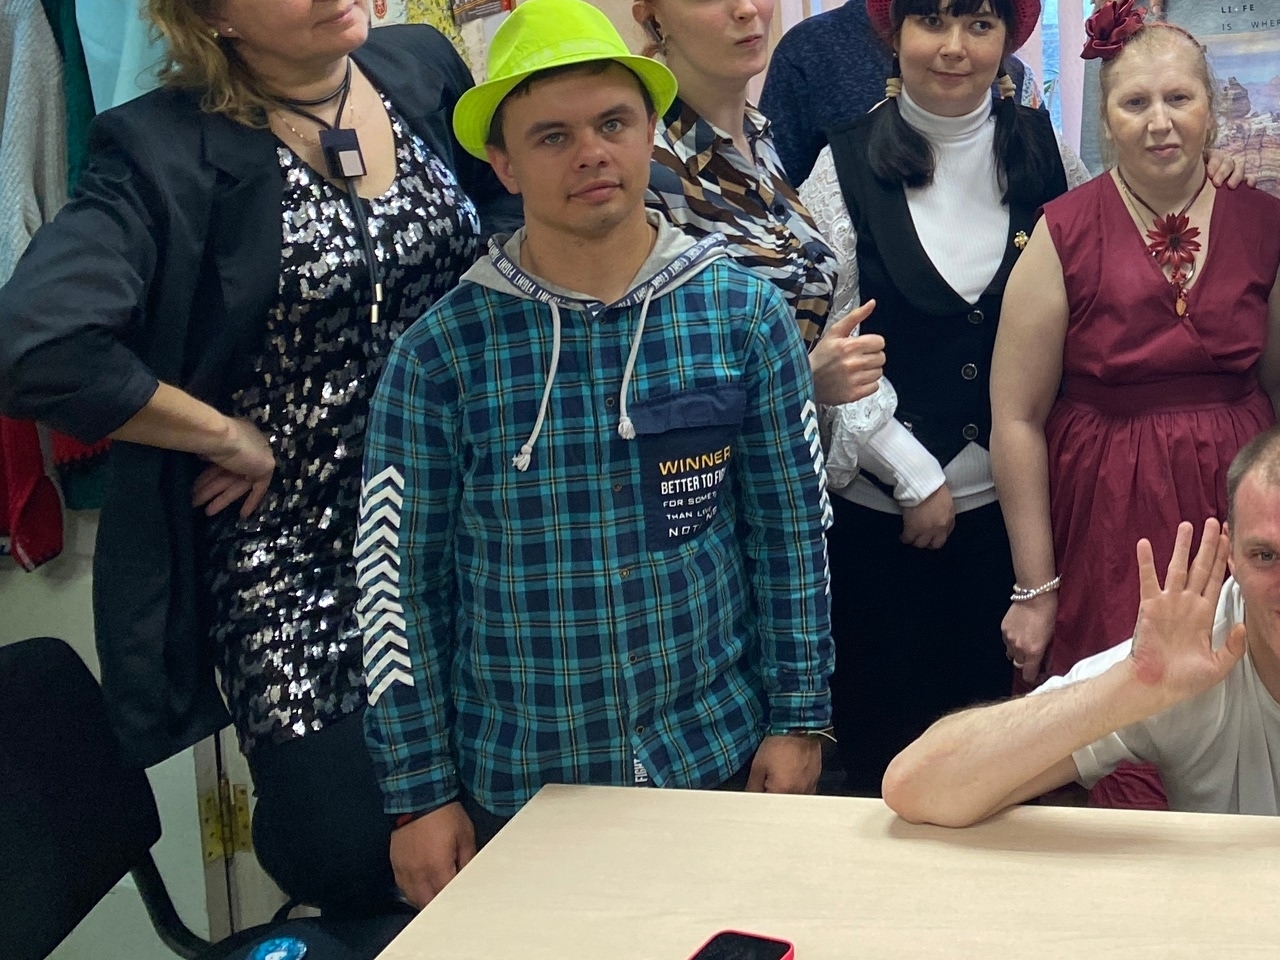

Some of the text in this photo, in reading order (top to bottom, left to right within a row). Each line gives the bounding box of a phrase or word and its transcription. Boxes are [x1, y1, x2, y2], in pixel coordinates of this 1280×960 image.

[513, 273, 537, 294] FIGHT
[659, 445, 730, 476] WINNER
[661, 476, 699, 495] BETTER
[701, 472, 713, 488] TO
[663, 499, 683, 508] FOR
[666, 511, 693, 520] THAN
